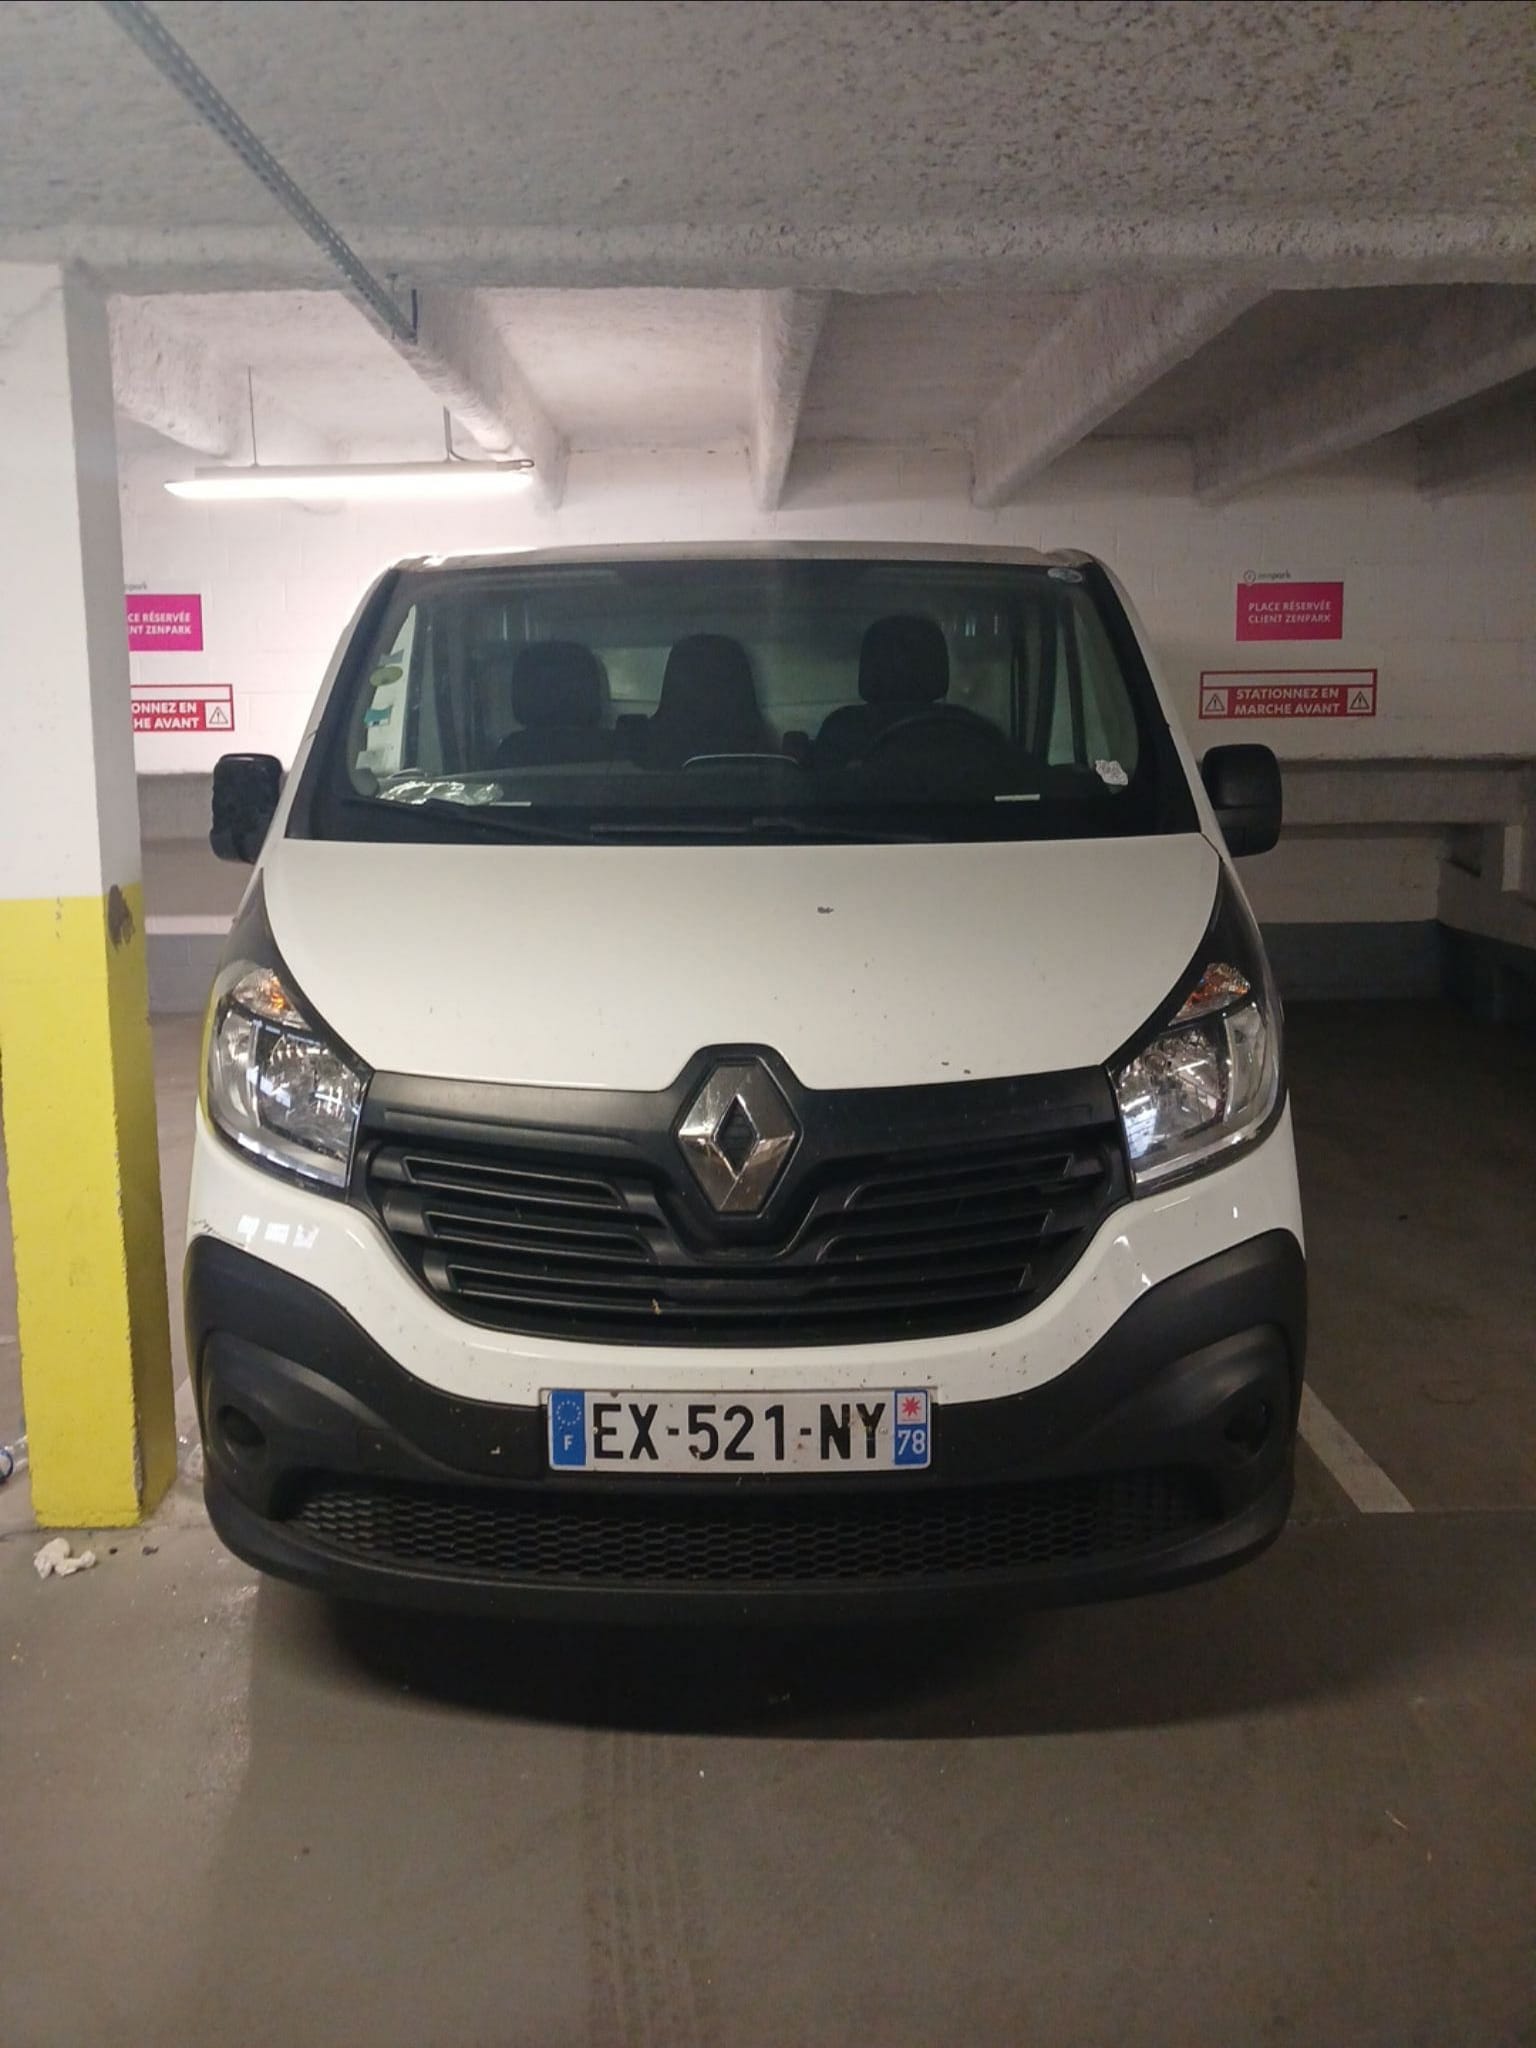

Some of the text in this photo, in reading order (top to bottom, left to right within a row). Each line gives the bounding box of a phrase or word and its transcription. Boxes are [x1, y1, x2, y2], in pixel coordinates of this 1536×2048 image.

[1248, 600, 1332, 612] PLACE RÉSERVÉE
[142, 610, 191, 623] RÉSERVÉE
[1248, 613, 1332, 624] CLIENT ZENPARK
[145, 624, 192, 635] ZENPARK
[1236, 688, 1340, 700] STATIONNEZ EN
[131, 702, 197, 714] ONNEZ EN
[1234, 703, 1341, 716] MARCHE AVANT
[154, 717, 200, 729] AVANT
[563, 1402, 926, 1462] F EX-521-NY 78
